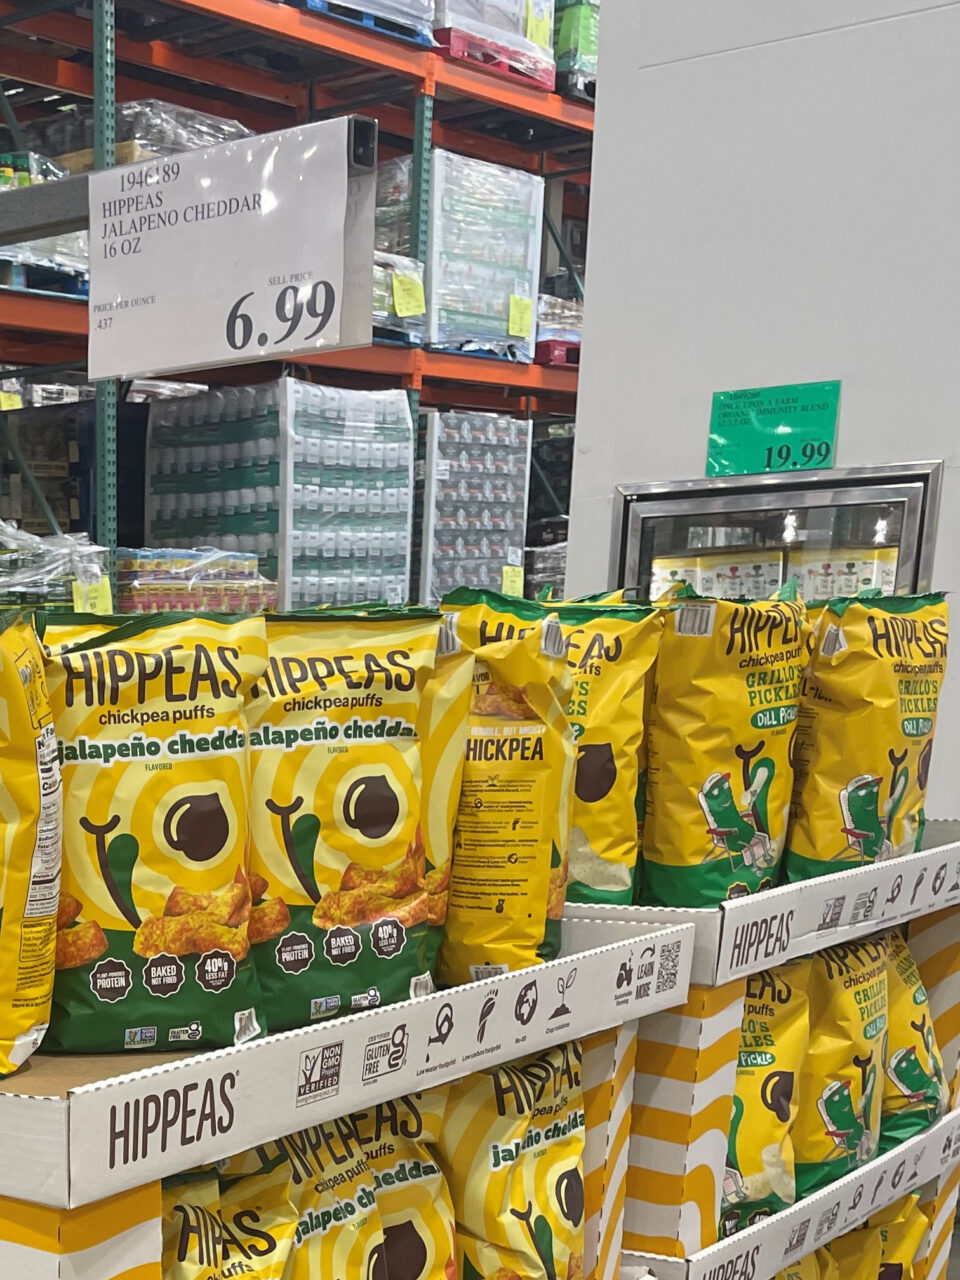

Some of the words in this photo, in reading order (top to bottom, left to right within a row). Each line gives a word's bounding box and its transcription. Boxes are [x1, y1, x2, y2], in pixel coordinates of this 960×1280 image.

[120, 163, 180, 192] 1946189
[102, 191, 163, 218] HIPPEAS
[102, 210, 178, 239] JALAPENO
[184, 193, 262, 223] CHEDDAR
[103, 242, 117, 259] 16
[121, 238, 141, 255] OZ
[268, 276, 288, 286] SELL
[290, 271, 313, 283] PRICE
[93, 303, 114, 313] PRICE
[131, 296, 155, 308] OUNCE
[226, 281, 335, 350] 6.99
[756, 406, 797, 416] IMMUNITY
[800, 403, 829, 412] BLEND
[764, 441, 831, 468] 19.99
[867, 616, 948, 660] HIPPEAS
[63, 644, 239, 708] HIPPEAS
[251, 649, 414, 699] HIPPEAS
[898, 680, 938, 695] GRILLO'S
[283, 696, 349, 712] chickpea
[350, 694, 383, 709] puffs
[99, 710, 170, 725] chickpea
[172, 704, 215, 723] puffs
[57, 736, 161, 765] jalapeño
[167, 730, 245, 755] chedda
[463, 735, 544, 762] HICKPEA
[144, 763, 173, 772] FLAVORED
[330, 935, 354, 947] BAKED
[377, 925, 397, 939] 40%
[730, 910, 795, 969] HIPPEAS
[281, 949, 309, 961] PROTEIN
[151, 965, 176, 977] BAKED
[205, 959, 228, 972] 40%
[636, 961, 655, 980] LEARN
[97, 977, 126, 989] PROTEIN
[205, 972, 217, 980] LESS
[218, 971, 228, 979] FAT
[634, 980, 651, 999] MORE
[747, 1004, 775, 1018] puffs
[368, 1031, 390, 1043] CERTIFIED
[323, 1046, 342, 1058] NON
[366, 1044, 390, 1062] GLUTEN
[322, 1055, 341, 1068] GMO
[364, 1060, 380, 1075] FREE
[321, 1066, 340, 1078] Project
[300, 1076, 339, 1096] VERIFIED
[108, 1071, 237, 1170] HIPPEAS
